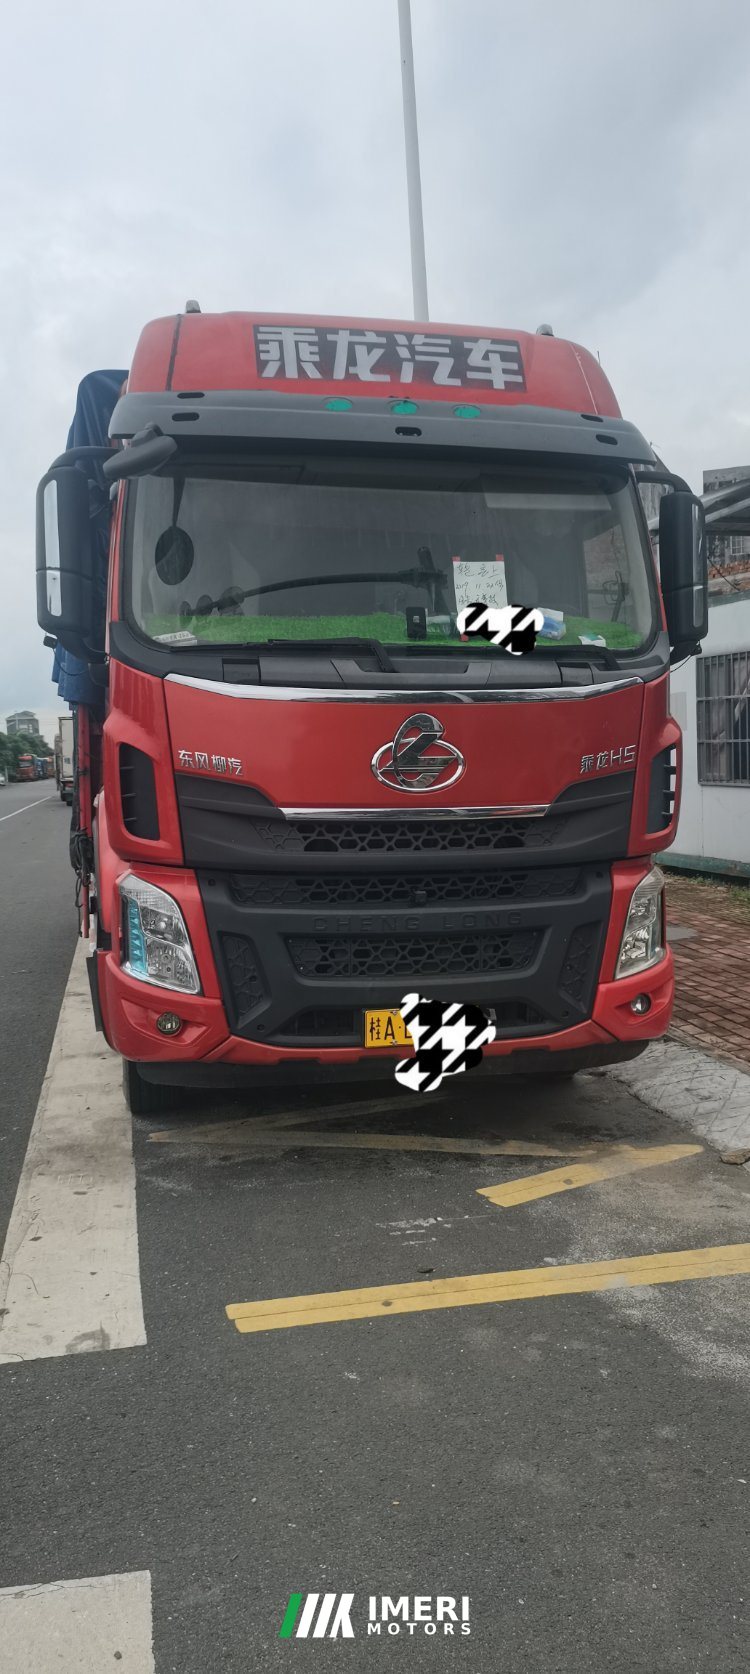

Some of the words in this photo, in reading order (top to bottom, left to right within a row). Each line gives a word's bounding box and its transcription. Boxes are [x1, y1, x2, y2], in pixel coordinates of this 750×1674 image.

[257, 326, 523, 390] 乘龙汽车
[178, 749, 243, 775] 东风柳汽
[312, 916, 420, 932] CHENG
[442, 911, 522, 930] LONG
